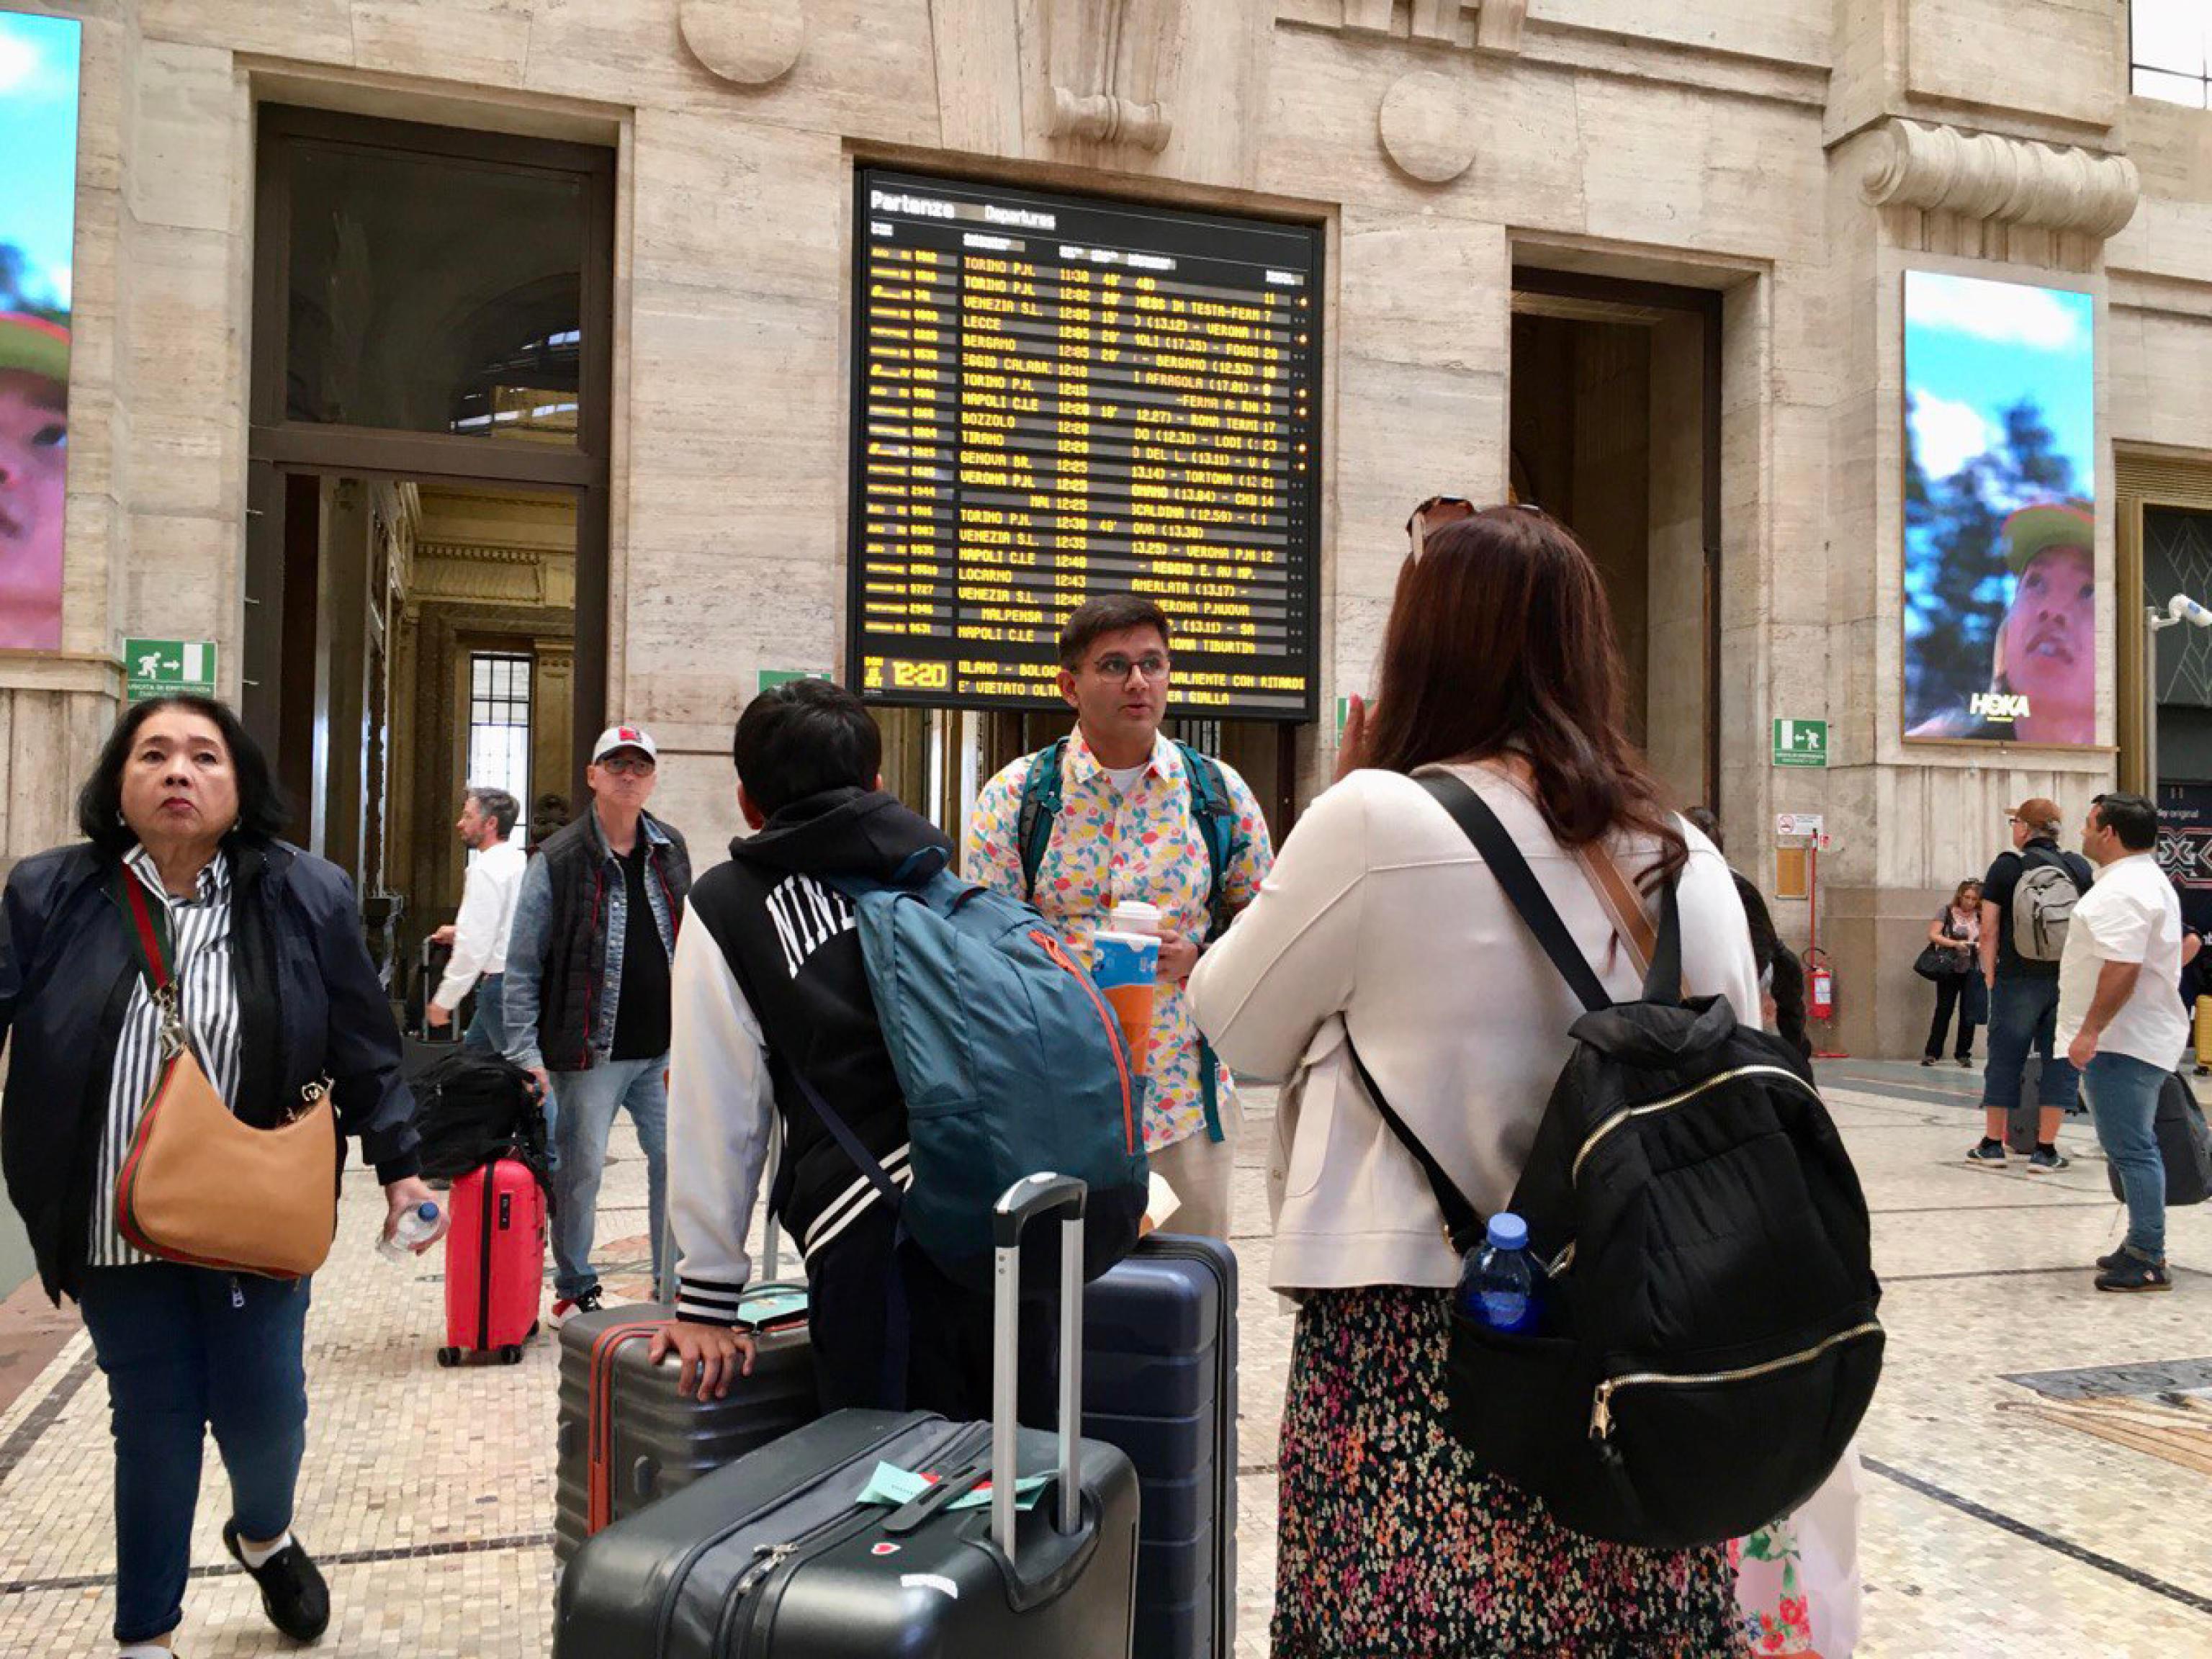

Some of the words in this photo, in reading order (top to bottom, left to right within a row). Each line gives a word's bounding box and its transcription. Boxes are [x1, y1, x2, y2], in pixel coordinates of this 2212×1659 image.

[871, 191, 954, 217] Partenze
[965, 257, 1006, 272] TORINO
[964, 276, 1006, 292] TORINO
[963, 296, 1014, 311] VENEZIA
[963, 315, 1000, 330] LECCE
[963, 334, 1015, 351] BERGAMO
[963, 373, 1004, 388] TORINO
[962, 392, 1005, 408] NAPOLI
[962, 413, 1015, 427] BOZZOLO
[963, 431, 1004, 445] TIRANO
[961, 451, 1006, 464] GENOVA
[961, 471, 1006, 485] VERONA
[961, 509, 1002, 523] TORINO
[960, 530, 1010, 543] VENEZIA
[959, 549, 1002, 562] NAPOLI
[958, 568, 1012, 582] LOCARNO
[958, 587, 1009, 601] VENEZIA
[981, 608, 1042, 622] MALPENSA
[958, 626, 1001, 639] NAPOLI
[893, 662, 945, 686] 12:20
[976, 682, 1025, 694] VIETATO
[1970, 693, 2031, 718] HOKA
